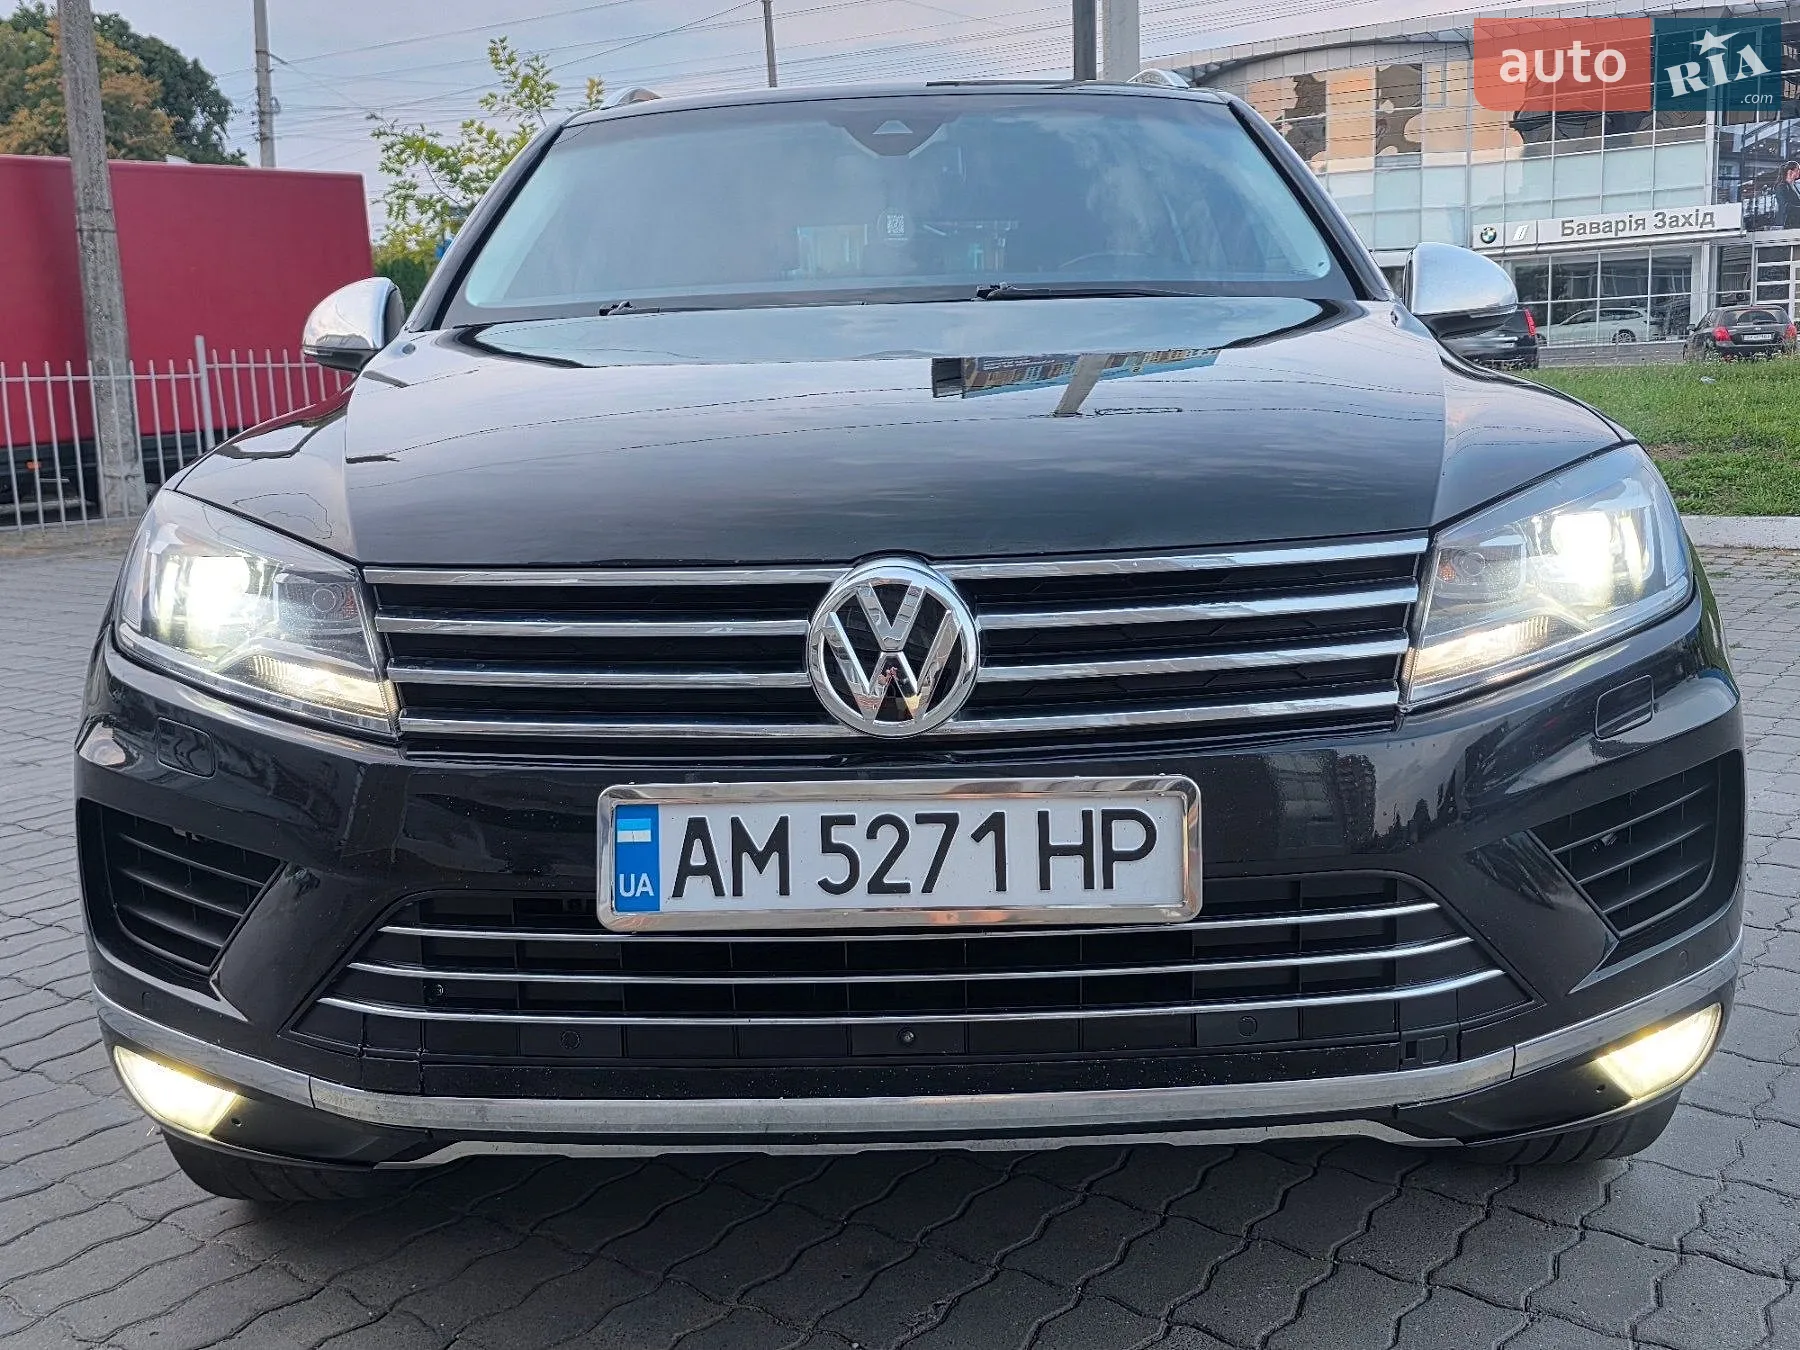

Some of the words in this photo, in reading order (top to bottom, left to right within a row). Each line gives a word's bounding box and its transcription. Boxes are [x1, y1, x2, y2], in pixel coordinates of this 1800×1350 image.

[1561, 214, 1646, 240] Баварія
[1653, 208, 1715, 230] Захід
[671, 815, 790, 898] AM
[817, 811, 1008, 895] 5271
[1038, 808, 1158, 891] HP
[619, 872, 655, 897] UA
